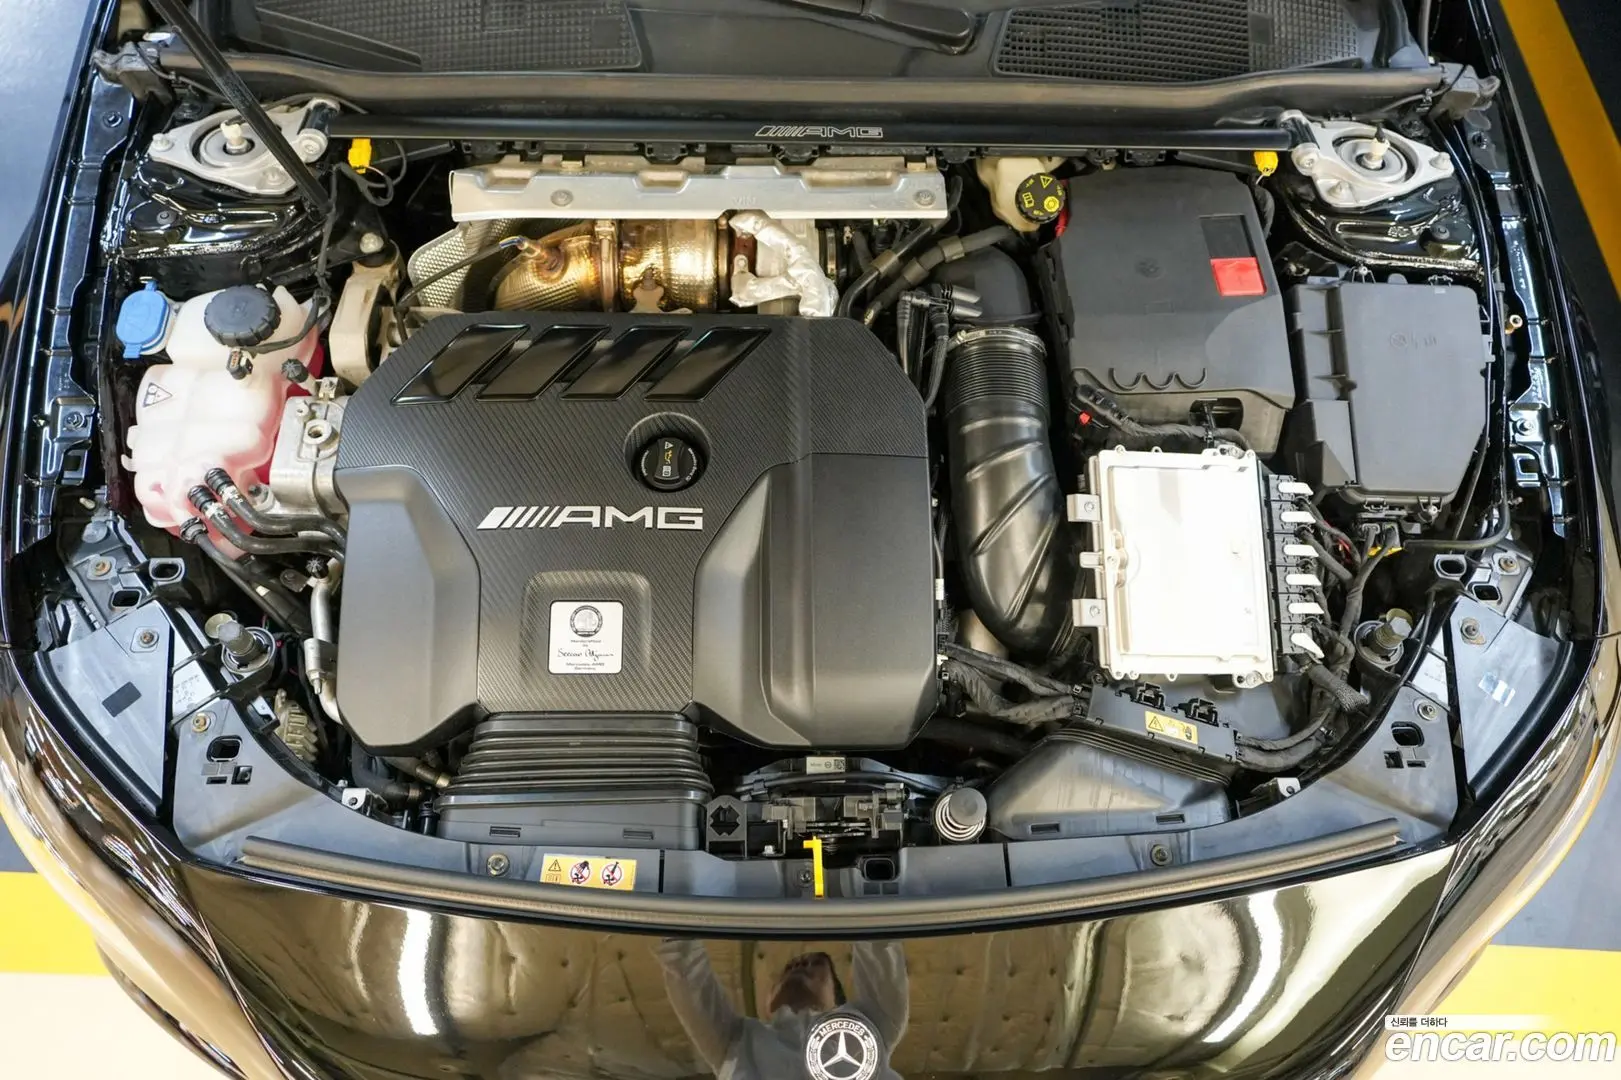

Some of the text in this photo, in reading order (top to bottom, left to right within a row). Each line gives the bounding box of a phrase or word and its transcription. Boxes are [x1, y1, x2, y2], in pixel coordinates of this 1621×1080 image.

[799, 125, 883, 138] AMG
[549, 505, 703, 530] AMG
[819, 1021, 865, 1037] MERCEDES
